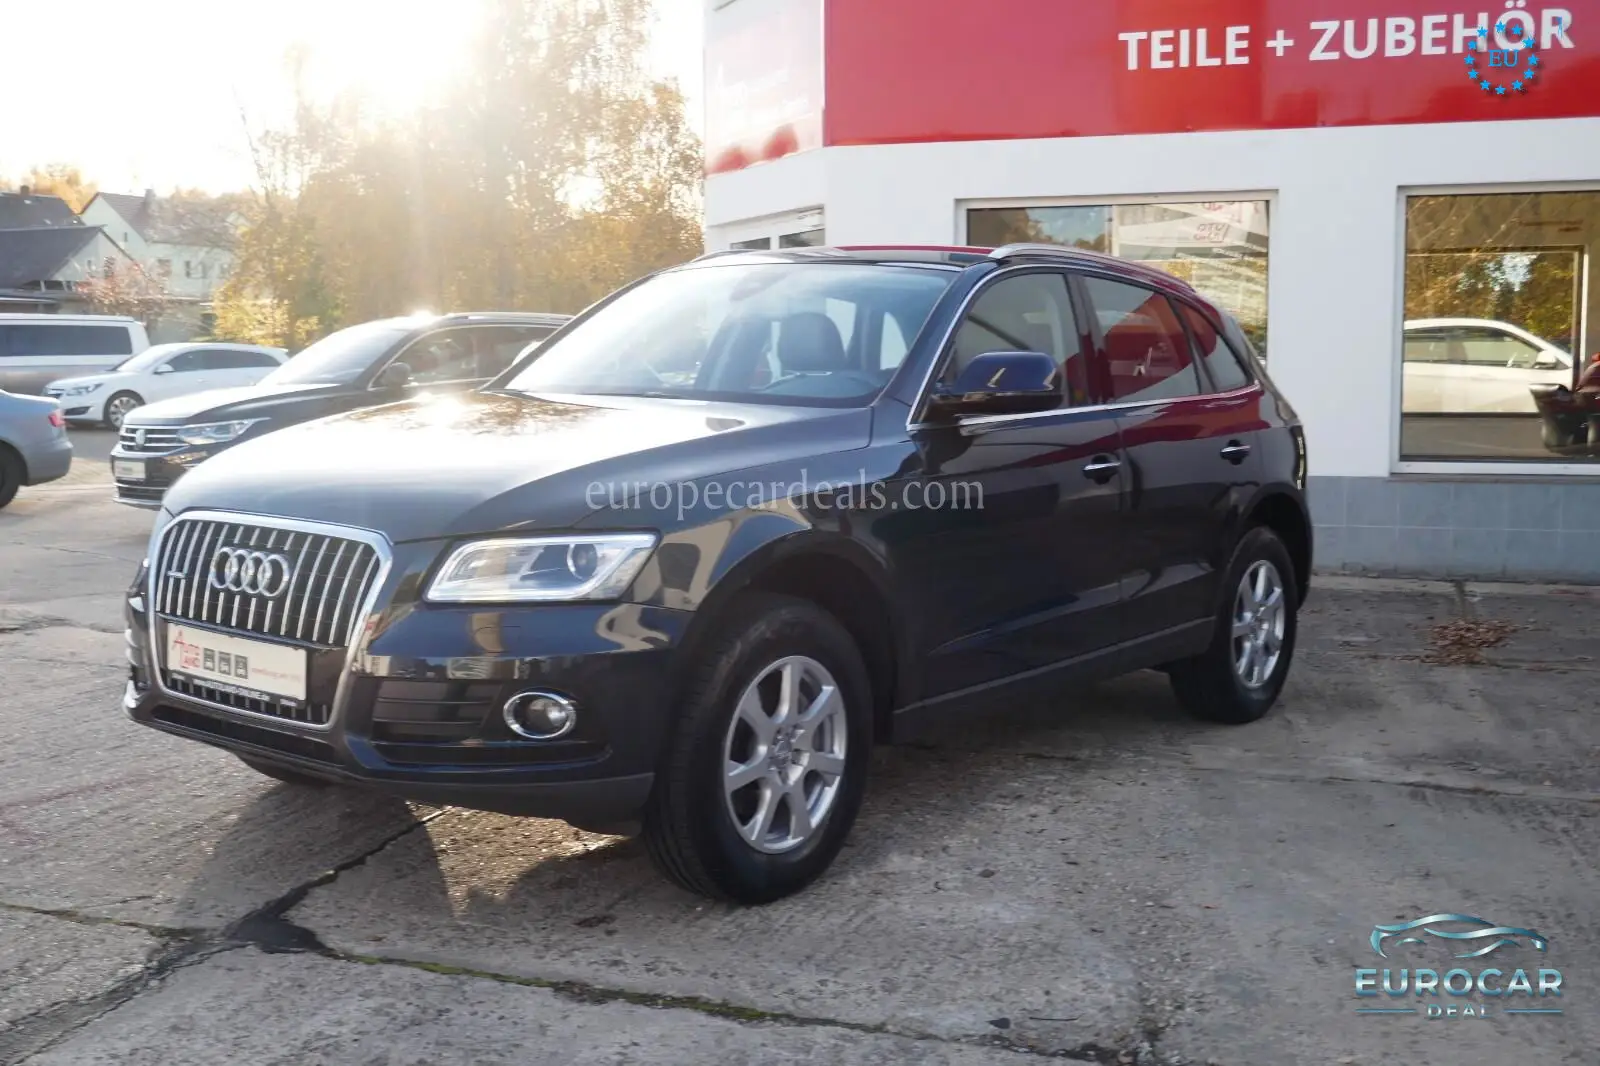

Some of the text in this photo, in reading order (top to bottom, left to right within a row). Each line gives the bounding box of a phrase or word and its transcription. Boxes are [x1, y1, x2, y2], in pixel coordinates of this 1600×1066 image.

[1118, 0, 1575, 70] TEILE + ZUBEHÖR
